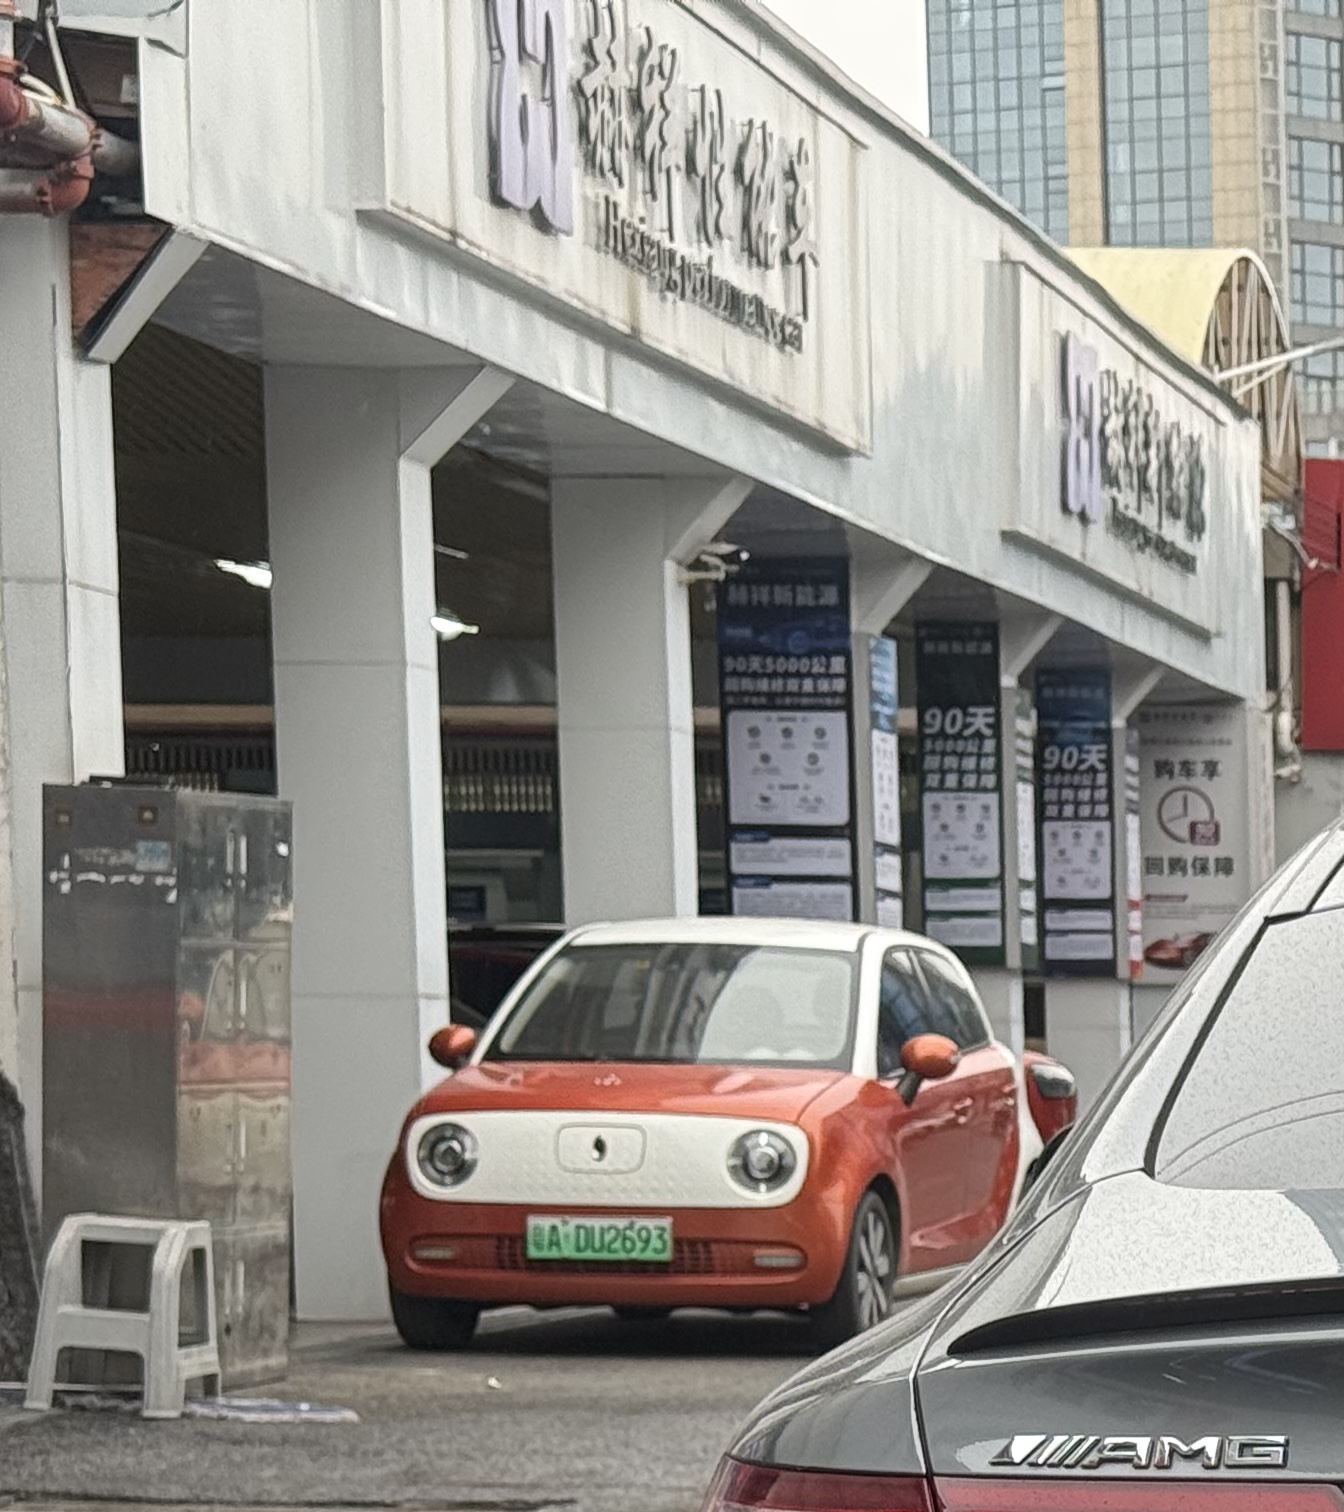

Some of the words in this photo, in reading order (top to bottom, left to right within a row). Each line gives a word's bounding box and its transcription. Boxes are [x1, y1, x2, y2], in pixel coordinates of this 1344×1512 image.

[923, 706, 997, 737] 90天
[1043, 744, 1108, 772] 90天
[1153, 758, 1222, 781] 购车享
[1143, 855, 1235, 878] 回购保障
[1081, 1434, 1290, 1470] AMG
